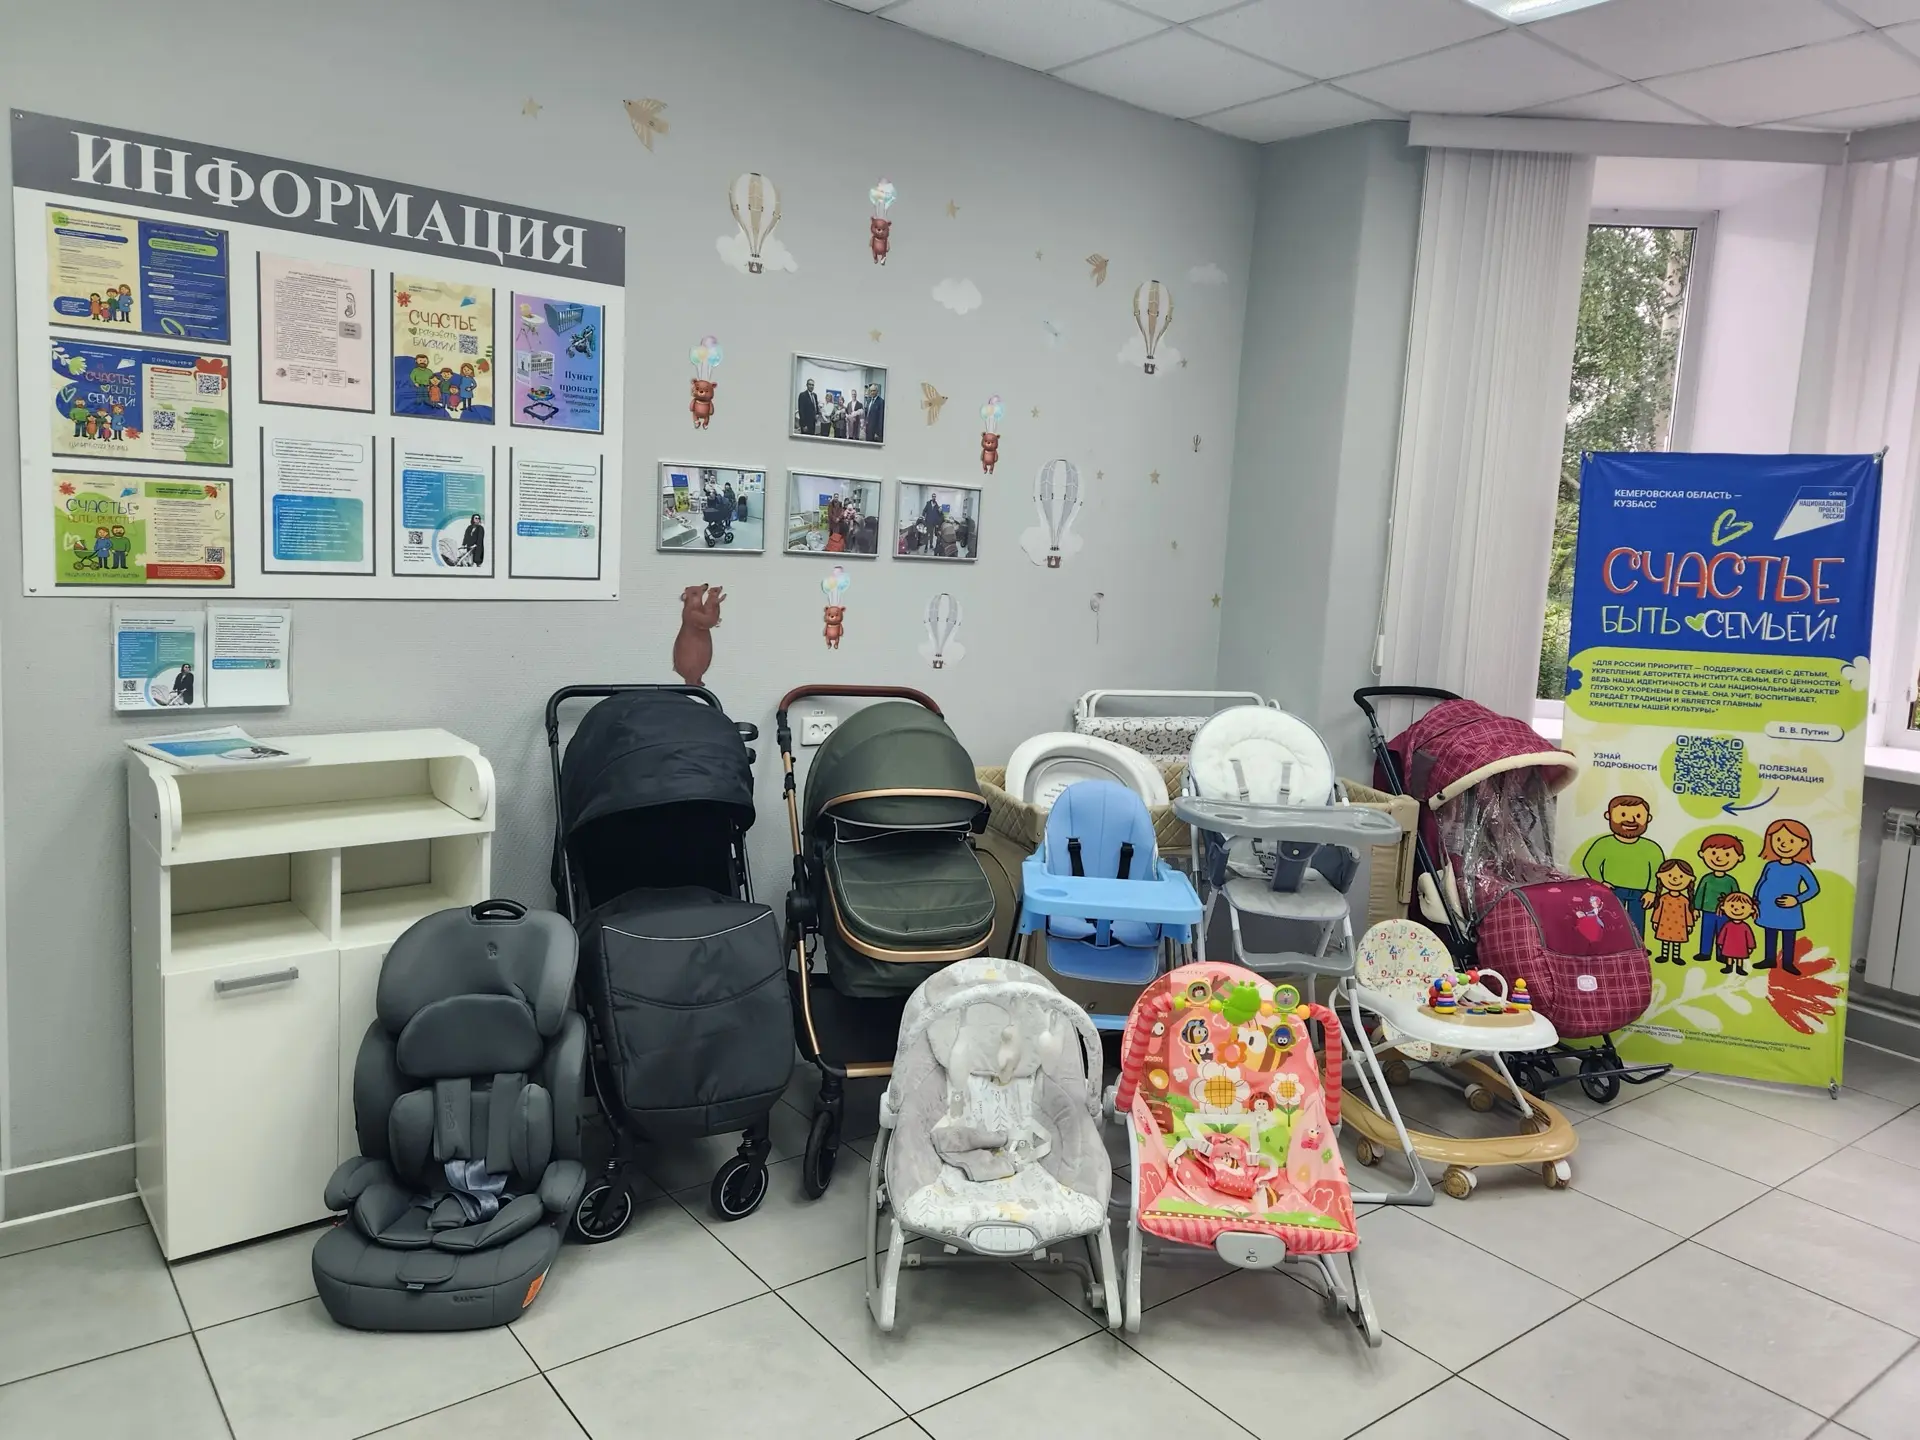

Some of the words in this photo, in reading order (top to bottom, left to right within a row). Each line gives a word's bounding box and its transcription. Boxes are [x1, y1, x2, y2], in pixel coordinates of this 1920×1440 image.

[70, 131, 587, 268] ИНФОРМАЦИЯ
[408, 309, 477, 332] СЧАСТЬЕ
[85, 371, 136, 386] СЧАСТЬЕ
[565, 370, 594, 381] Пункт
[560, 384, 598, 394] проката
[1614, 489, 1684, 499] КЕМЕРОВСКАЯ
[1686, 490, 1732, 499] ОБЛАСТЬ
[65, 498, 137, 515] СЧАСТЬЕ
[1613, 499, 1657, 508] КУЗБАСС
[1602, 546, 1845, 605] СЧАСТЬЕ
[1601, 605, 1681, 635] БЫТЬ
[1614, 660, 1646, 668] РОССИИ
[1648, 662, 1693, 670] ПРИОРИТЕТ
[1703, 665, 1753, 674] ПОДДЕРЖКА
[1754, 667, 1784, 675] СЕМЕЙ
[1591, 668, 1641, 676] УКРЕПЛЕНИЕ
[1642, 671, 1692, 679] АВТОРИТЕТА
[1693, 674, 1739, 682] ИНСТИТУТА
[1626, 686, 1673, 694] УКОРЕНЕНЫ
[1636, 679, 1700, 688] ИДЕНТИЧНОСТЬ
[1728, 684, 1797, 693] НАЦИОНАЛЬНЫЙ
[1589, 701, 1640, 709] ХРАНИТЕЛЕМ
[1630, 694, 1672, 703] ТРАДИЦИИ
[1681, 698, 1721, 706] ЯВЛЯЕТСЯ
[1722, 700, 1763, 708] ГЛАВНЫМ
[1800, 727, 1830, 736] Путин
[1593, 751, 1621, 761] УЗНАЙ
[1592, 760, 1658, 772] ПОДРОБНОСТИ
[1759, 764, 1808, 774] ПОЛЕЗНАЯ
[1758, 773, 1825, 784] ИНФОРМАЦИЯ
